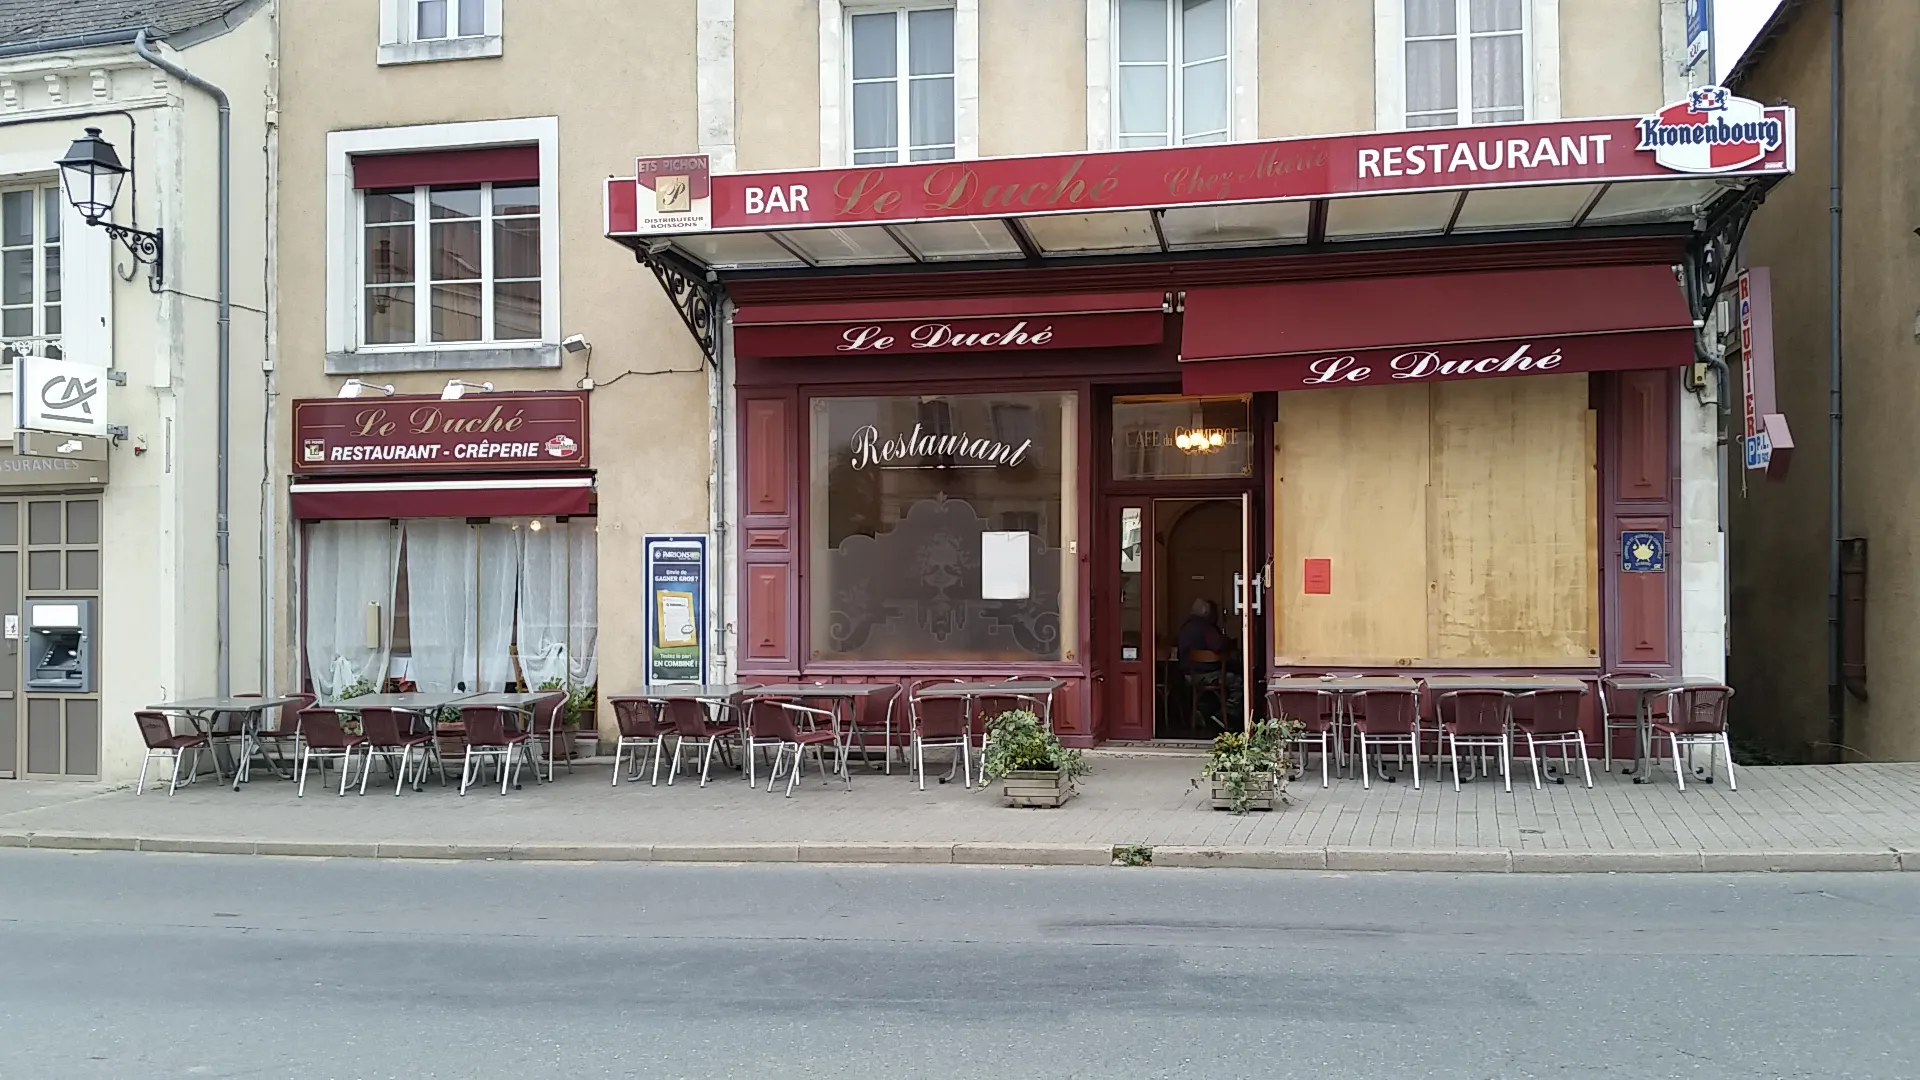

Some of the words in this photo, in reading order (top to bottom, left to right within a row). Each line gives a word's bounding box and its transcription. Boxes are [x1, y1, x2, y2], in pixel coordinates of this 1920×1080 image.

[1642, 116, 1779, 147] Kronenbourg
[639, 161, 658, 173] ETS
[662, 157, 706, 171] PICHON
[1358, 134, 1612, 179] RESTAURANT
[833, 169, 902, 216] Le
[922, 158, 1119, 212] Duché
[1163, 165, 1233, 200] Chez
[1239, 146, 1328, 182] Marie
[745, 185, 810, 215] BAR
[836, 326, 895, 350] Le
[910, 321, 1054, 348] Duché
[1303, 356, 1371, 384] Le
[1390, 344, 1563, 379] Duché
[350, 408, 397, 437] Le
[409, 405, 524, 434] Duché
[330, 444, 441, 461] RESTAURANT
[454, 439, 540, 458] CRÊPERIE
[851, 423, 1032, 471] Restaurant
[1164, 434, 1173, 446] du
[0, 459, 79, 471] SURANCES
[664, 660, 694, 668] COMBINÉ
